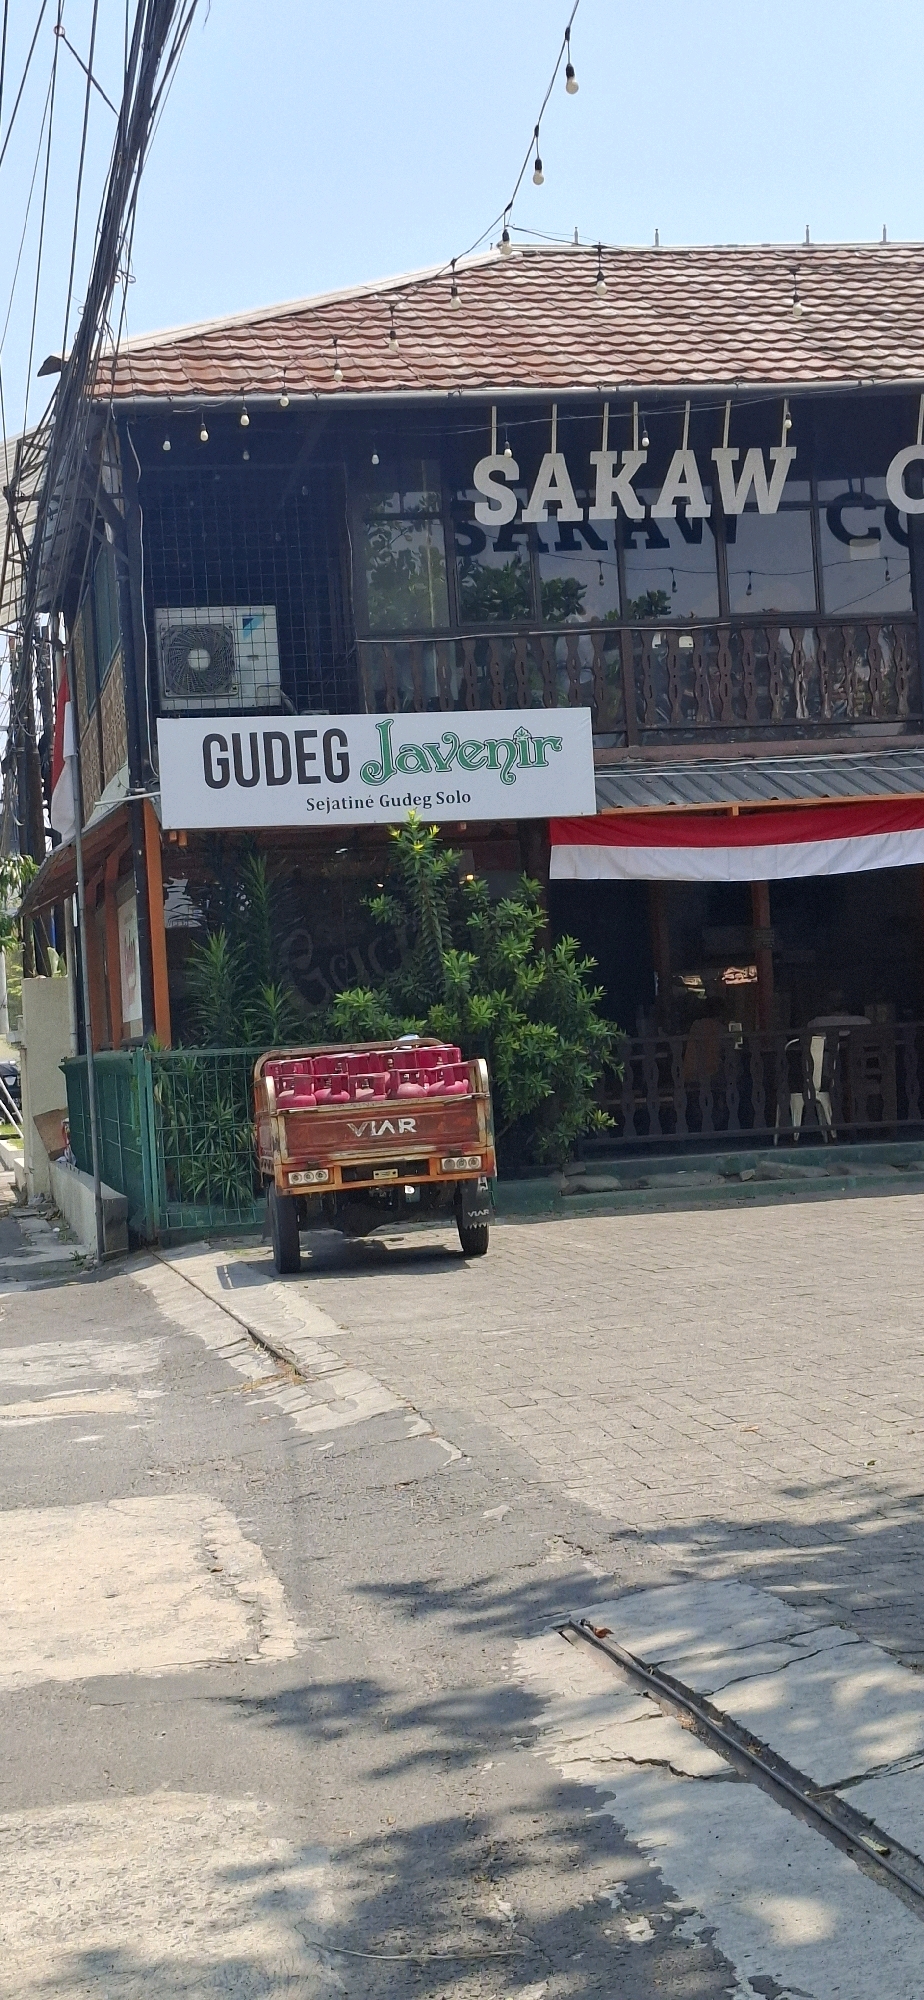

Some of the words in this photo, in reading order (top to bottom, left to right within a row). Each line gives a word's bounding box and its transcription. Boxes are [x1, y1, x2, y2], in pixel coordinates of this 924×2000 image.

[473, 446, 797, 526] SAKAW
[202, 728, 351, 789] GUDEG
[358, 718, 563, 786] Javenir
[306, 795, 374, 814] Sejatiné
[379, 793, 432, 809] Gudeg
[436, 790, 471, 805] Solo
[347, 1118, 417, 1137] VIAR
[467, 1208, 490, 1218] VIAR
